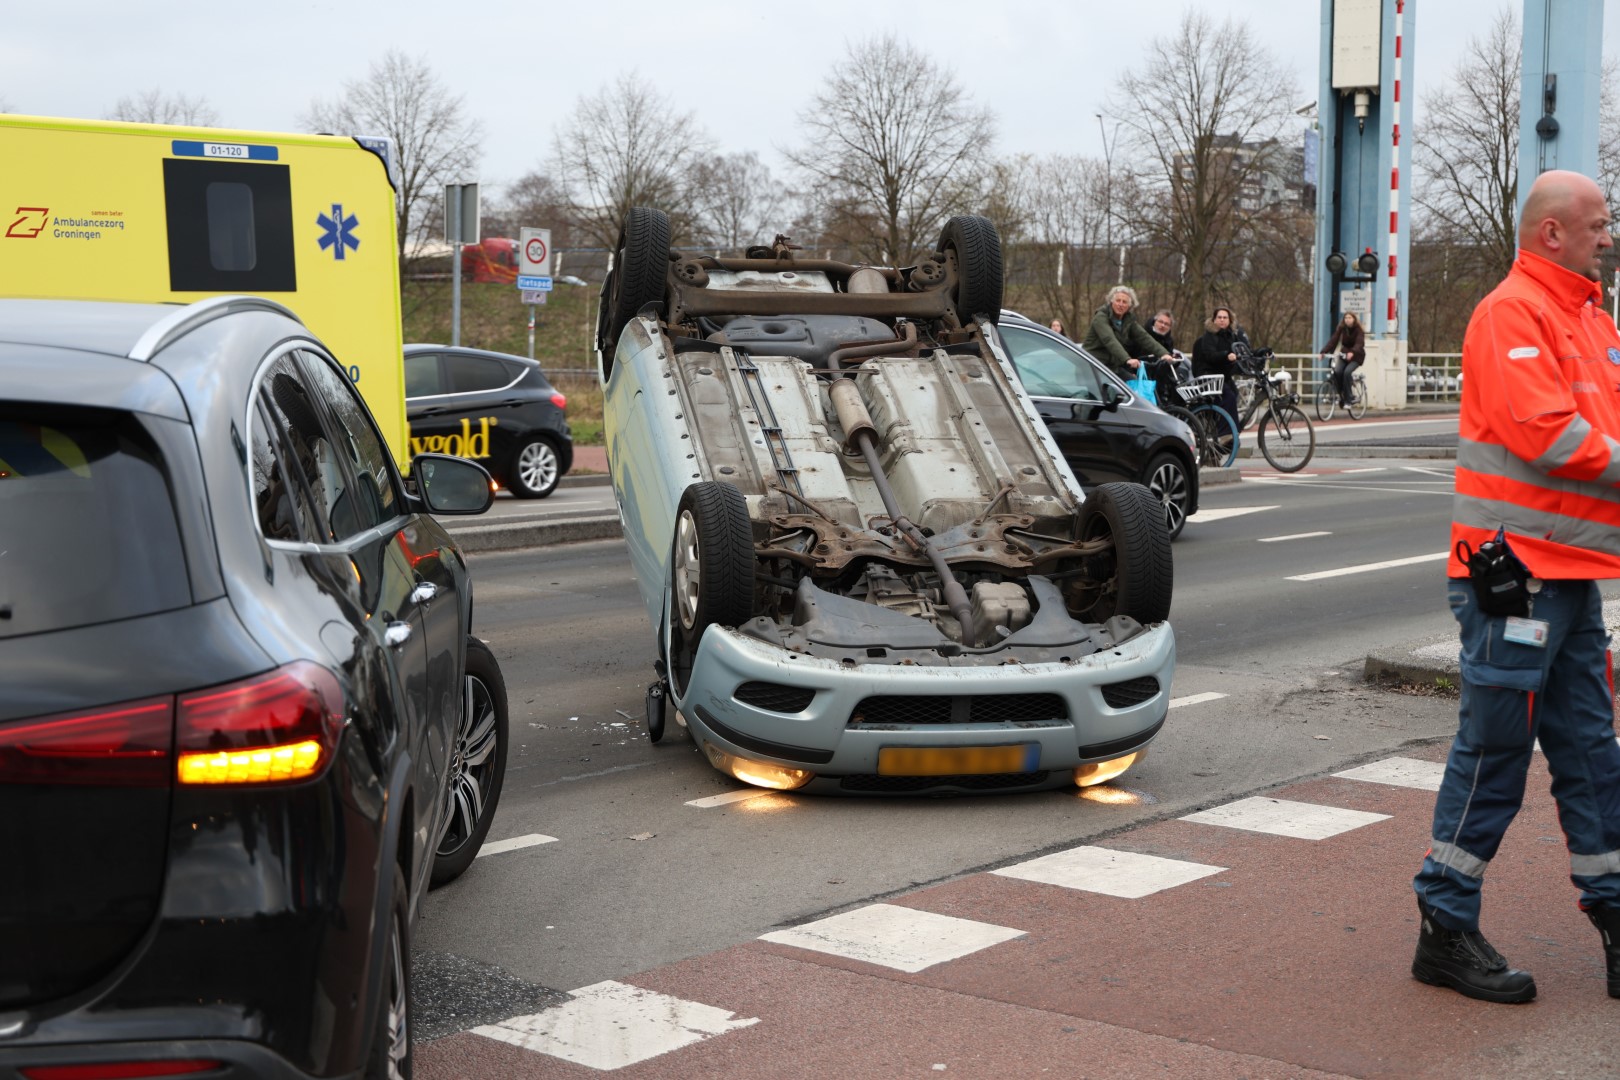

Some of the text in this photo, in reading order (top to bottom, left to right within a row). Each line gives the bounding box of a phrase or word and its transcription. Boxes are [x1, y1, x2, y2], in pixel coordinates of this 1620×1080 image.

[211, 145, 242, 156] 01-120
[53, 217, 124, 230] Ambulancezorg
[53, 229, 101, 240] Groningen
[530, 246, 543, 257] 30
